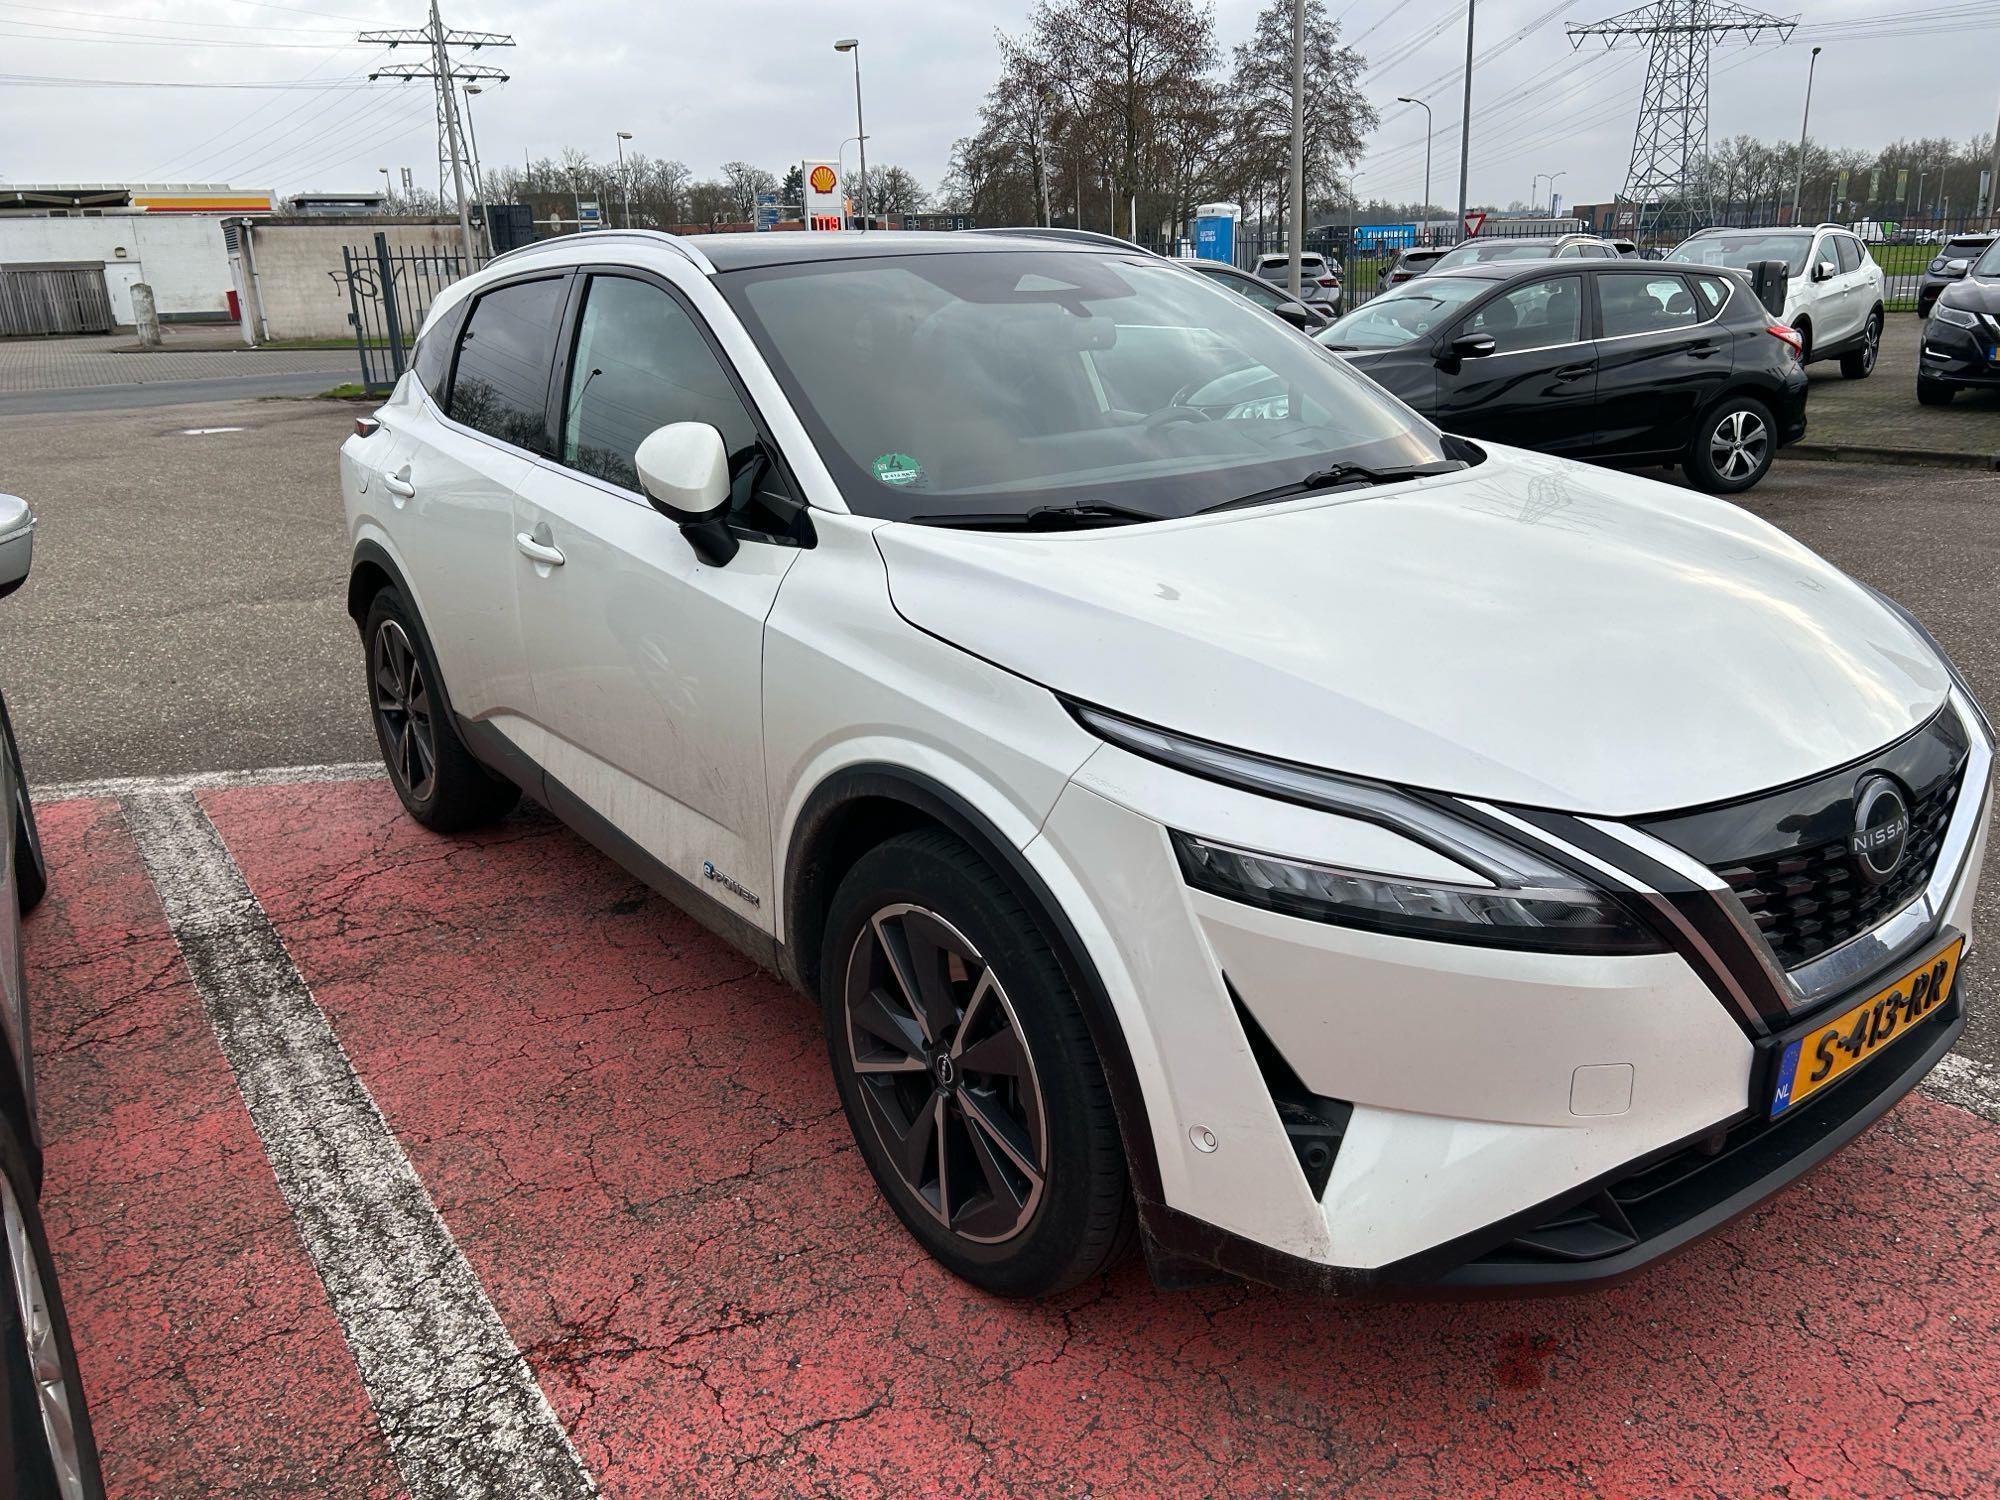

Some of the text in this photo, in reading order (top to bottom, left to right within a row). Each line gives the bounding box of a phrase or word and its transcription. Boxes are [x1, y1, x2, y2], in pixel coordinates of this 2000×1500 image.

[889, 455, 903, 469] 4
[1853, 815, 1909, 851] NISSAN
[1810, 959, 1949, 1082] S-413-RR
[1774, 1083, 1790, 1103] NL
